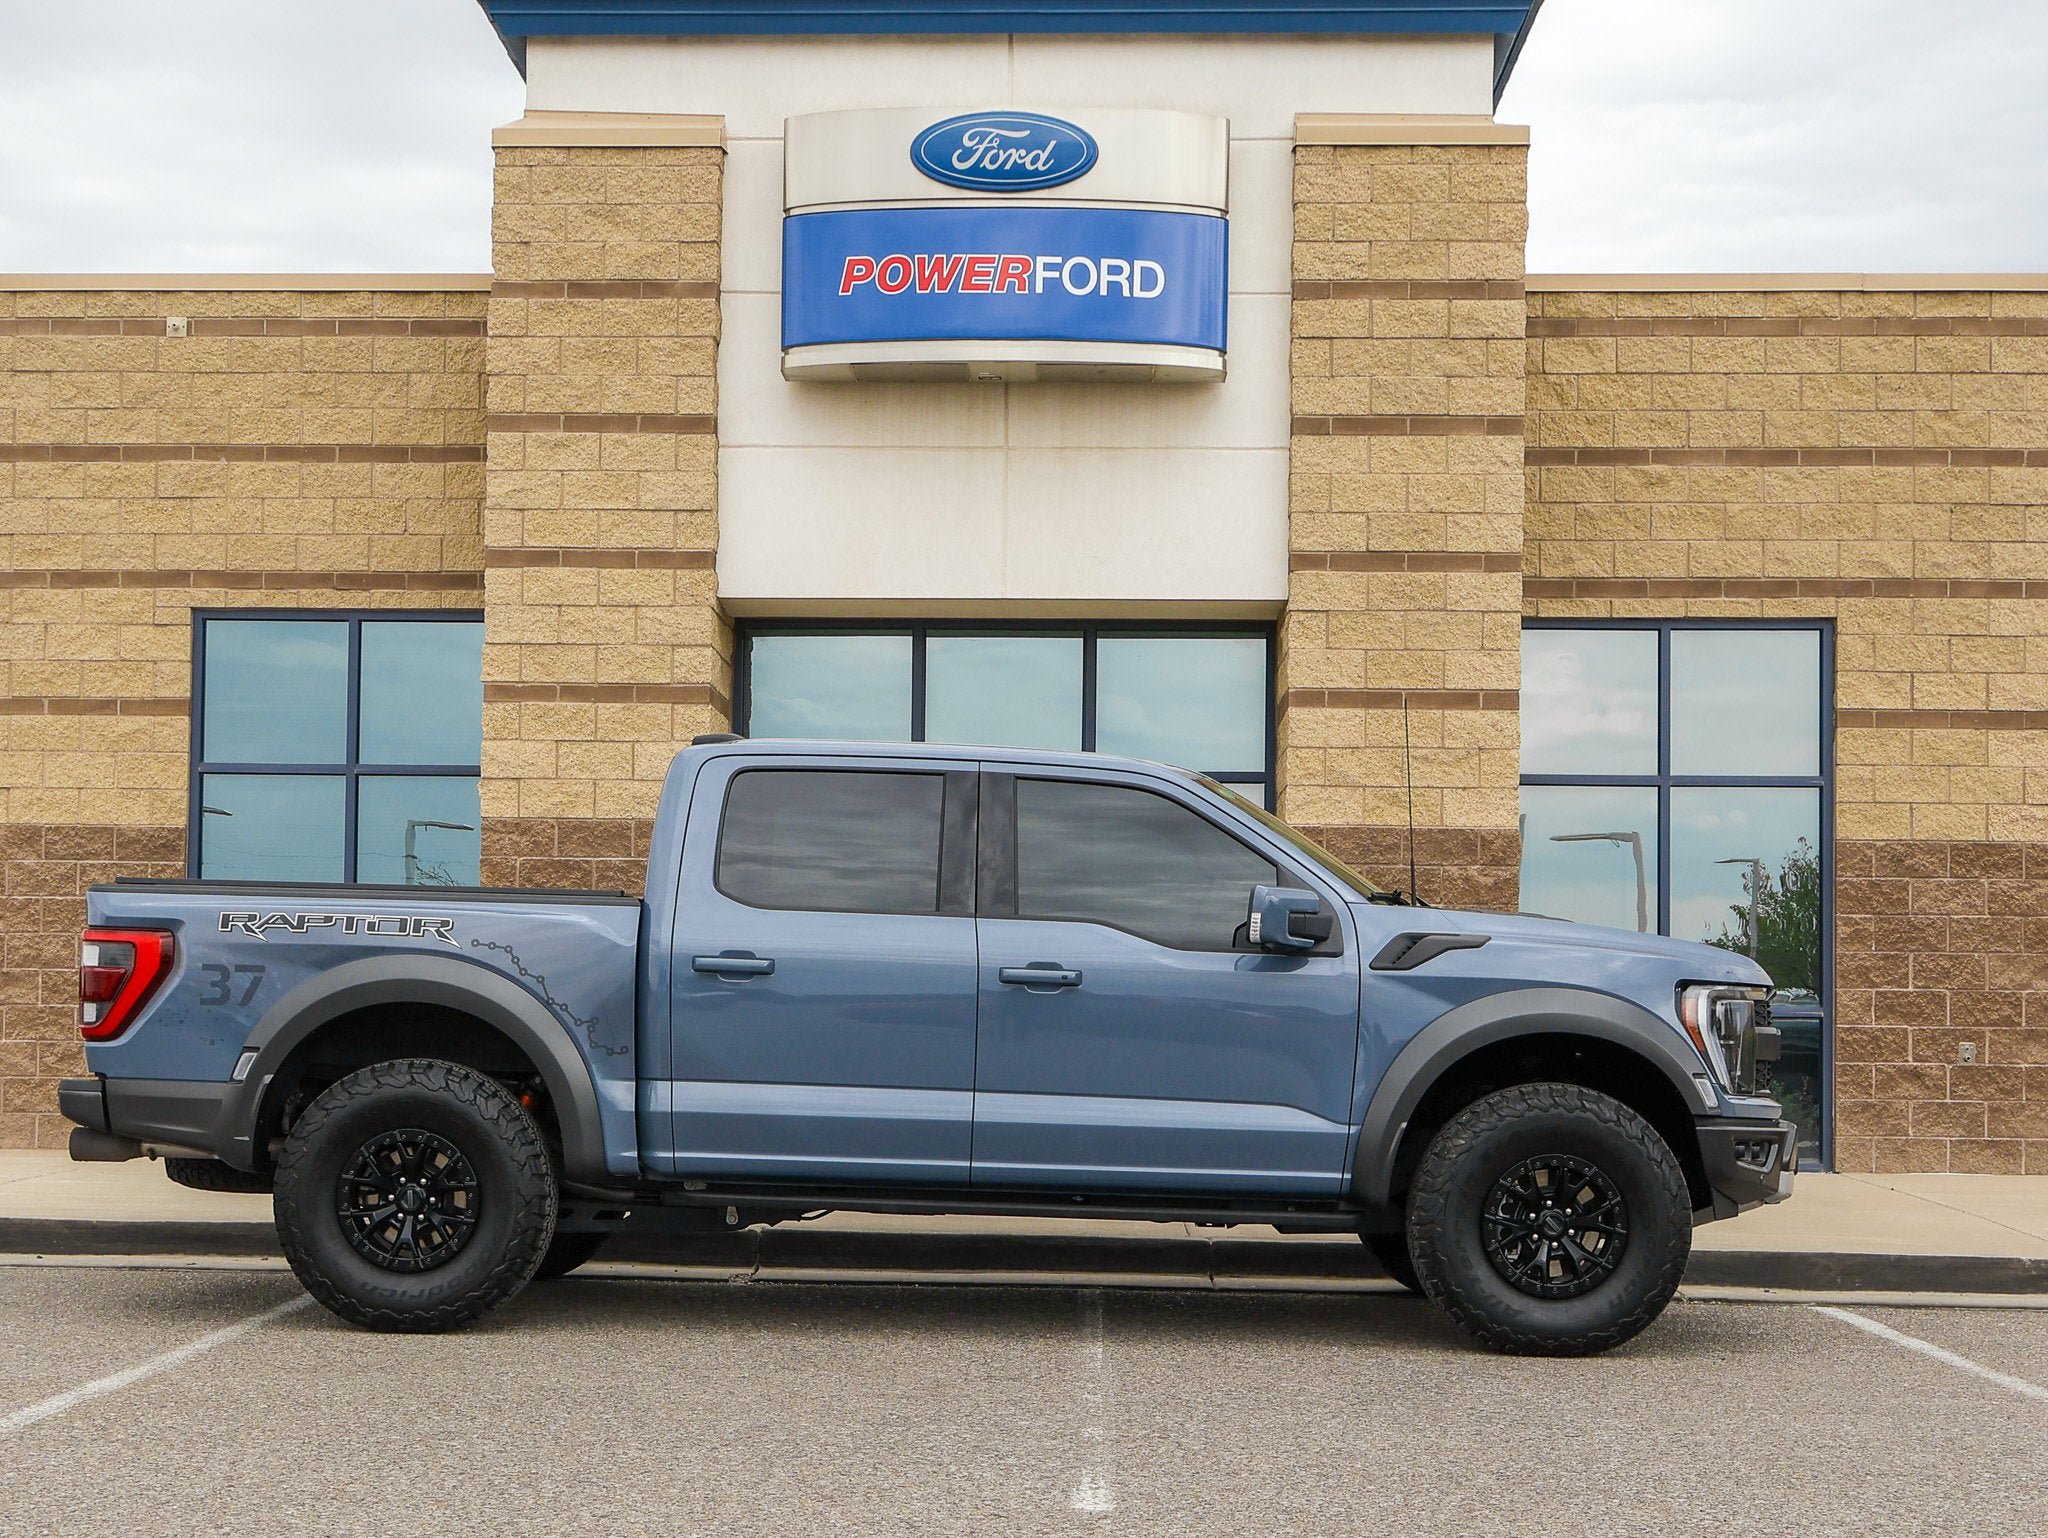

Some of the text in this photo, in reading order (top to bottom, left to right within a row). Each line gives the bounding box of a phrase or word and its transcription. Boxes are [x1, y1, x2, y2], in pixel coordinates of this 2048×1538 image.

[951, 127, 1056, 171] Ford
[838, 253, 1166, 299] POWERFORD
[218, 911, 461, 948] RAPTOR
[200, 964, 265, 1007] 37
